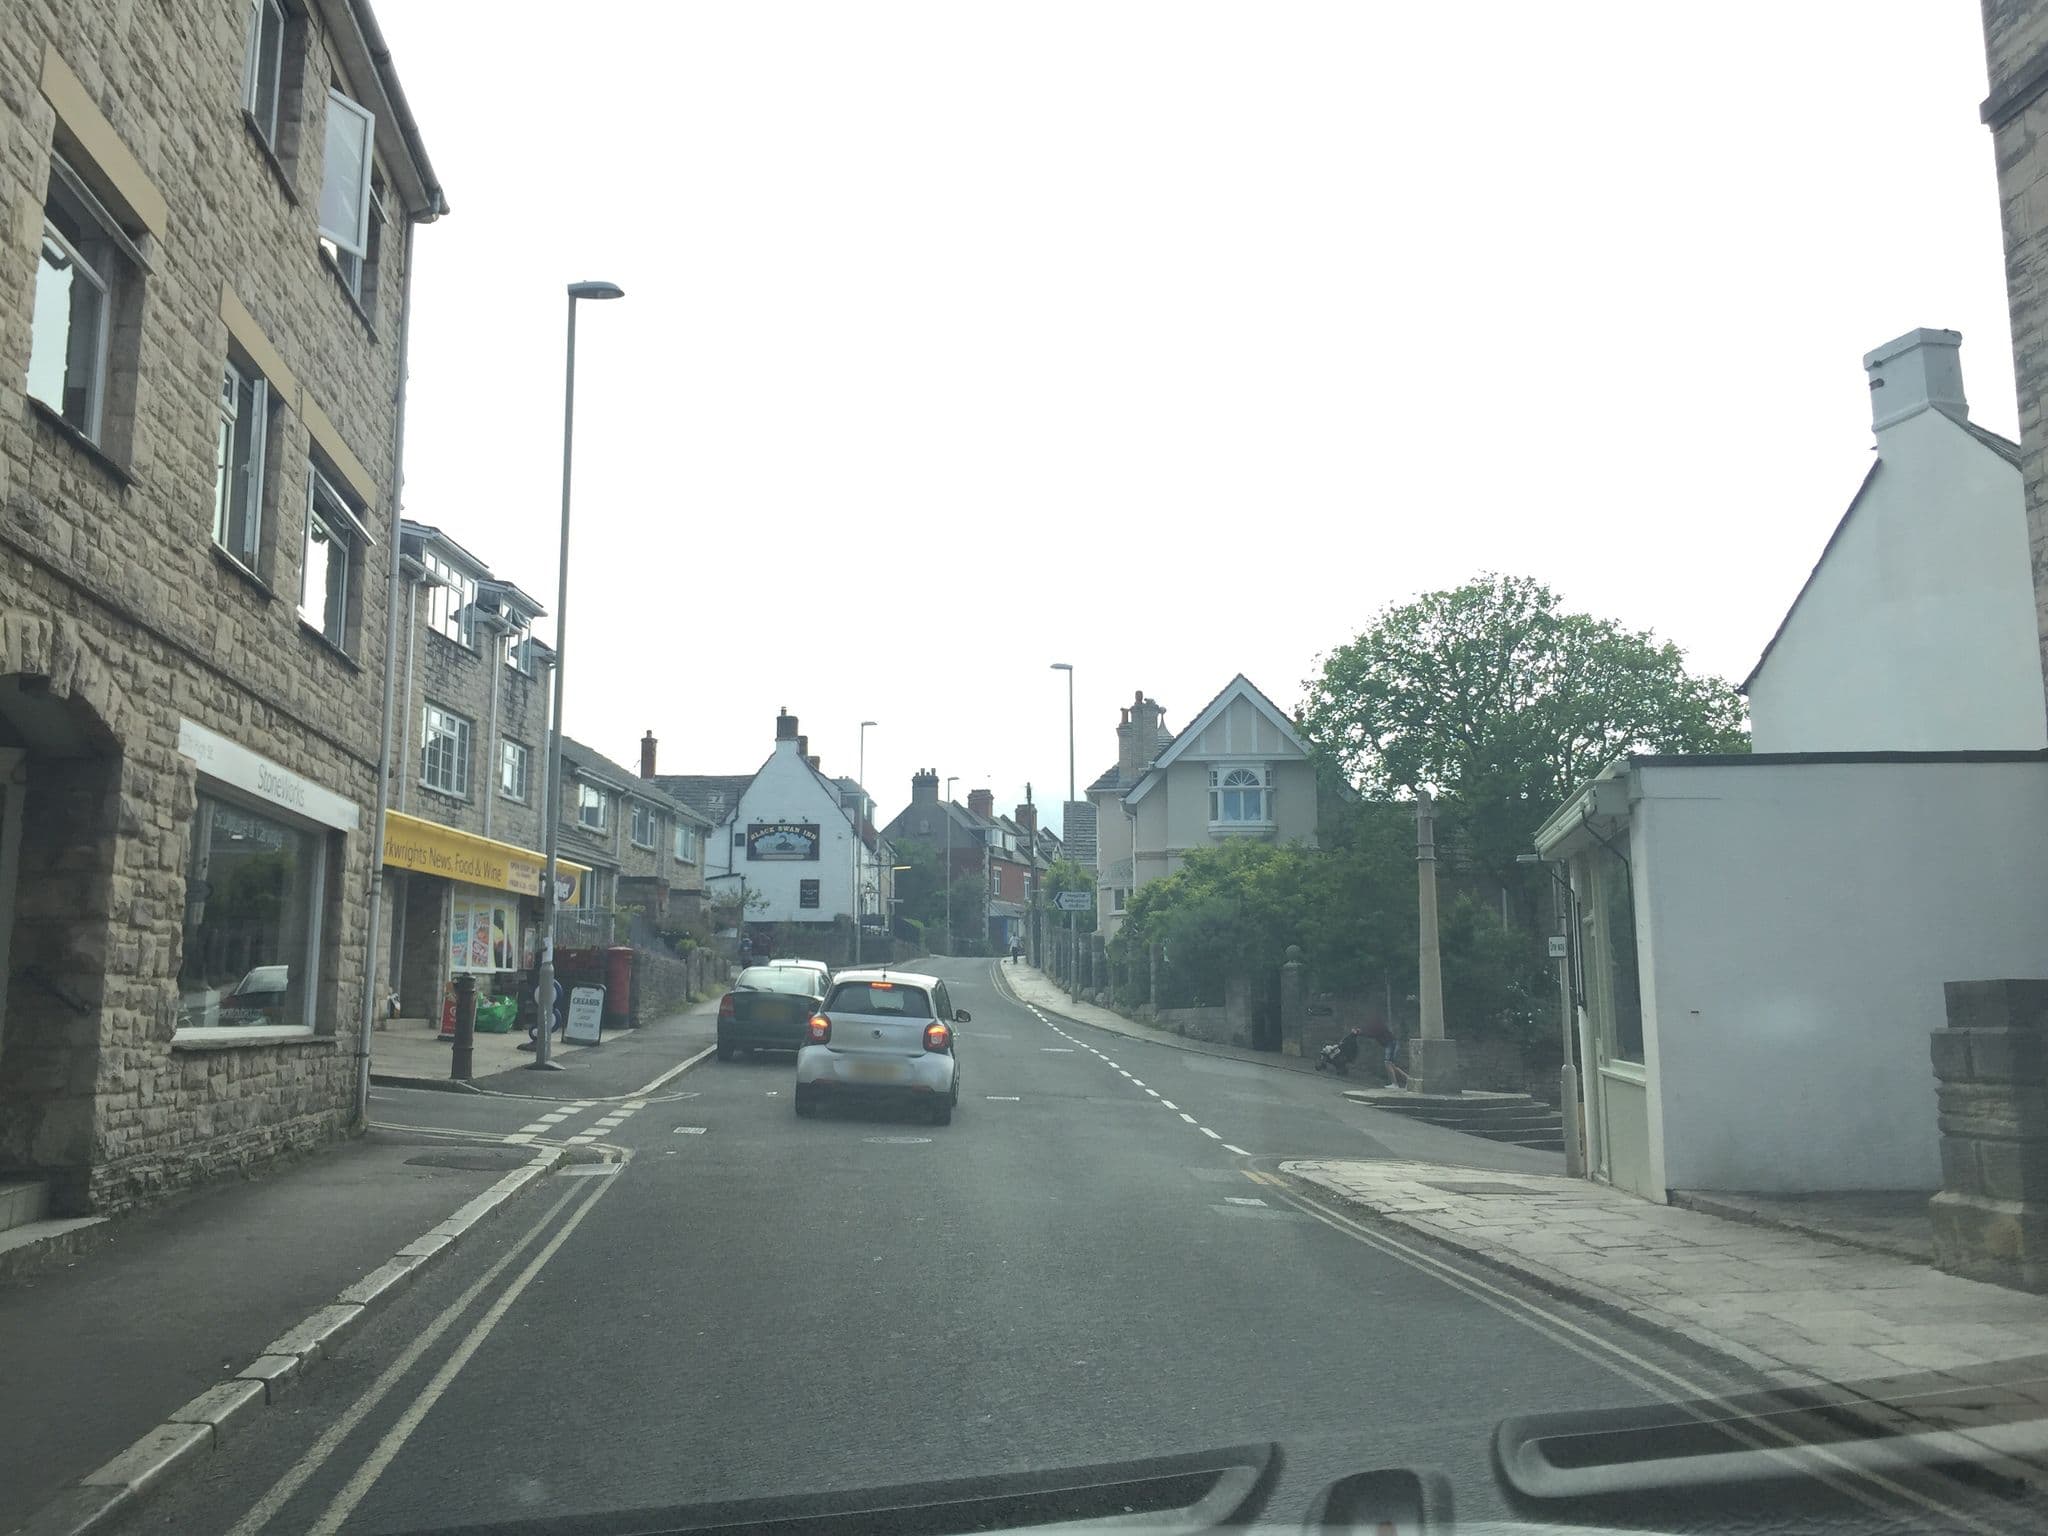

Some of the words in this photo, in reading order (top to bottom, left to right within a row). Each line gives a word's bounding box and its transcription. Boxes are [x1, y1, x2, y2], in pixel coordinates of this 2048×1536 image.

[257, 763, 305, 807] StoneWorks
[751, 827, 775, 841] BLACK
[777, 825, 801, 833] SWAN
[803, 829, 817, 840] INN
[383, 836, 427, 867] rkwrights
[455, 852, 473, 876] Food
[475, 860, 482, 877] &
[483, 859, 502, 882] Wine
